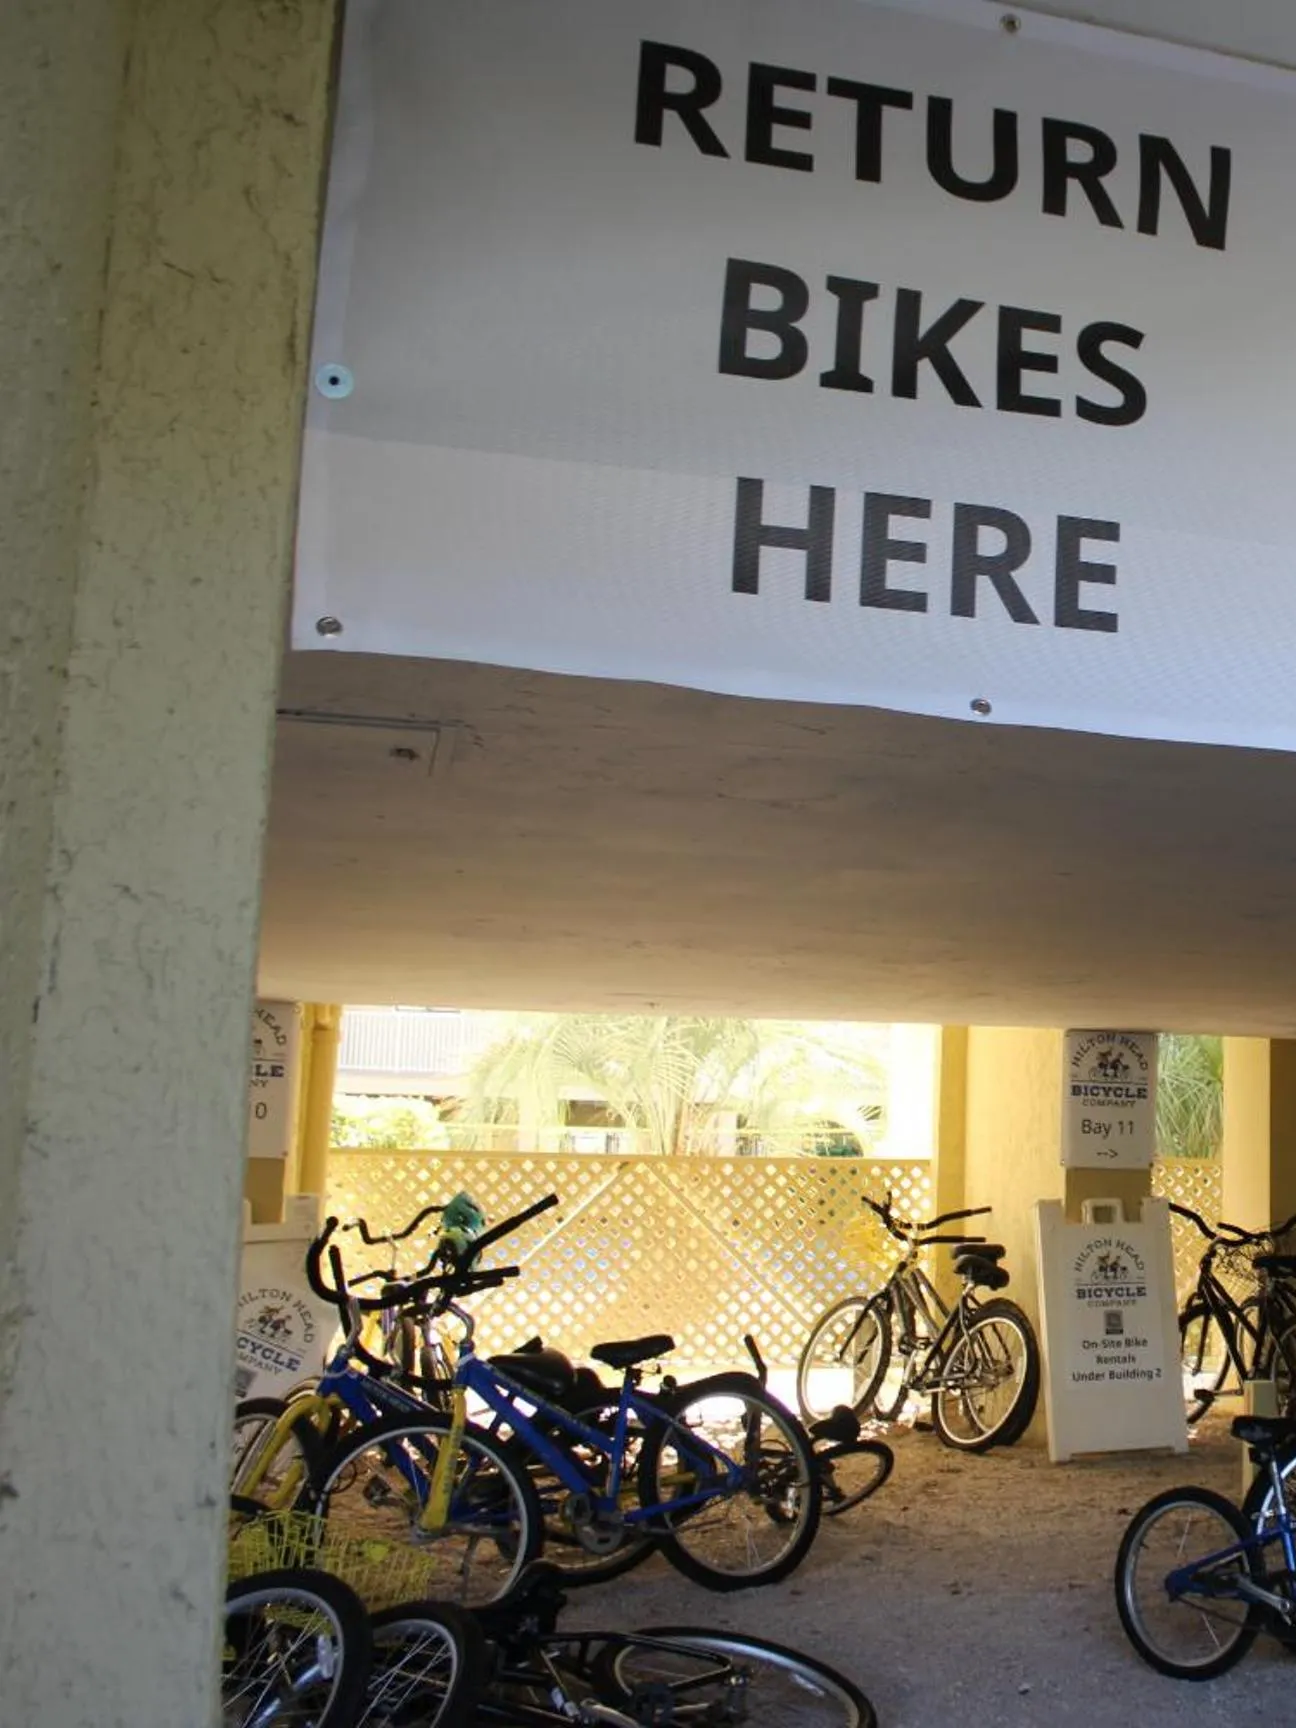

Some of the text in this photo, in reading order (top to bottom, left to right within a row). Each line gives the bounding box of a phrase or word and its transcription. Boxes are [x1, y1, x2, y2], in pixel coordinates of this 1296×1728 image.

[634, 39, 1232, 251] RETURN
[718, 257, 1148, 427] BIKES
[731, 476, 1121, 633] HERE
[1071, 1033, 1149, 1071] HILTON HEAD
[1070, 1084, 1149, 1100] BICYCLE
[1082, 1099, 1137, 1108] COMPANY
[1080, 1119, 1135, 1139] Bay 11
[1073, 1238, 1145, 1272] HILTON HEAD
[1075, 1286, 1147, 1299] BICYCLE
[1086, 1299, 1137, 1308] COMPANY
[292, 1299, 314, 1344] HEAD
[1124, 1336, 1149, 1348] Bike
[1095, 1353, 1137, 1365] Rentals
[1071, 1367, 1162, 1382] Under Building 2
